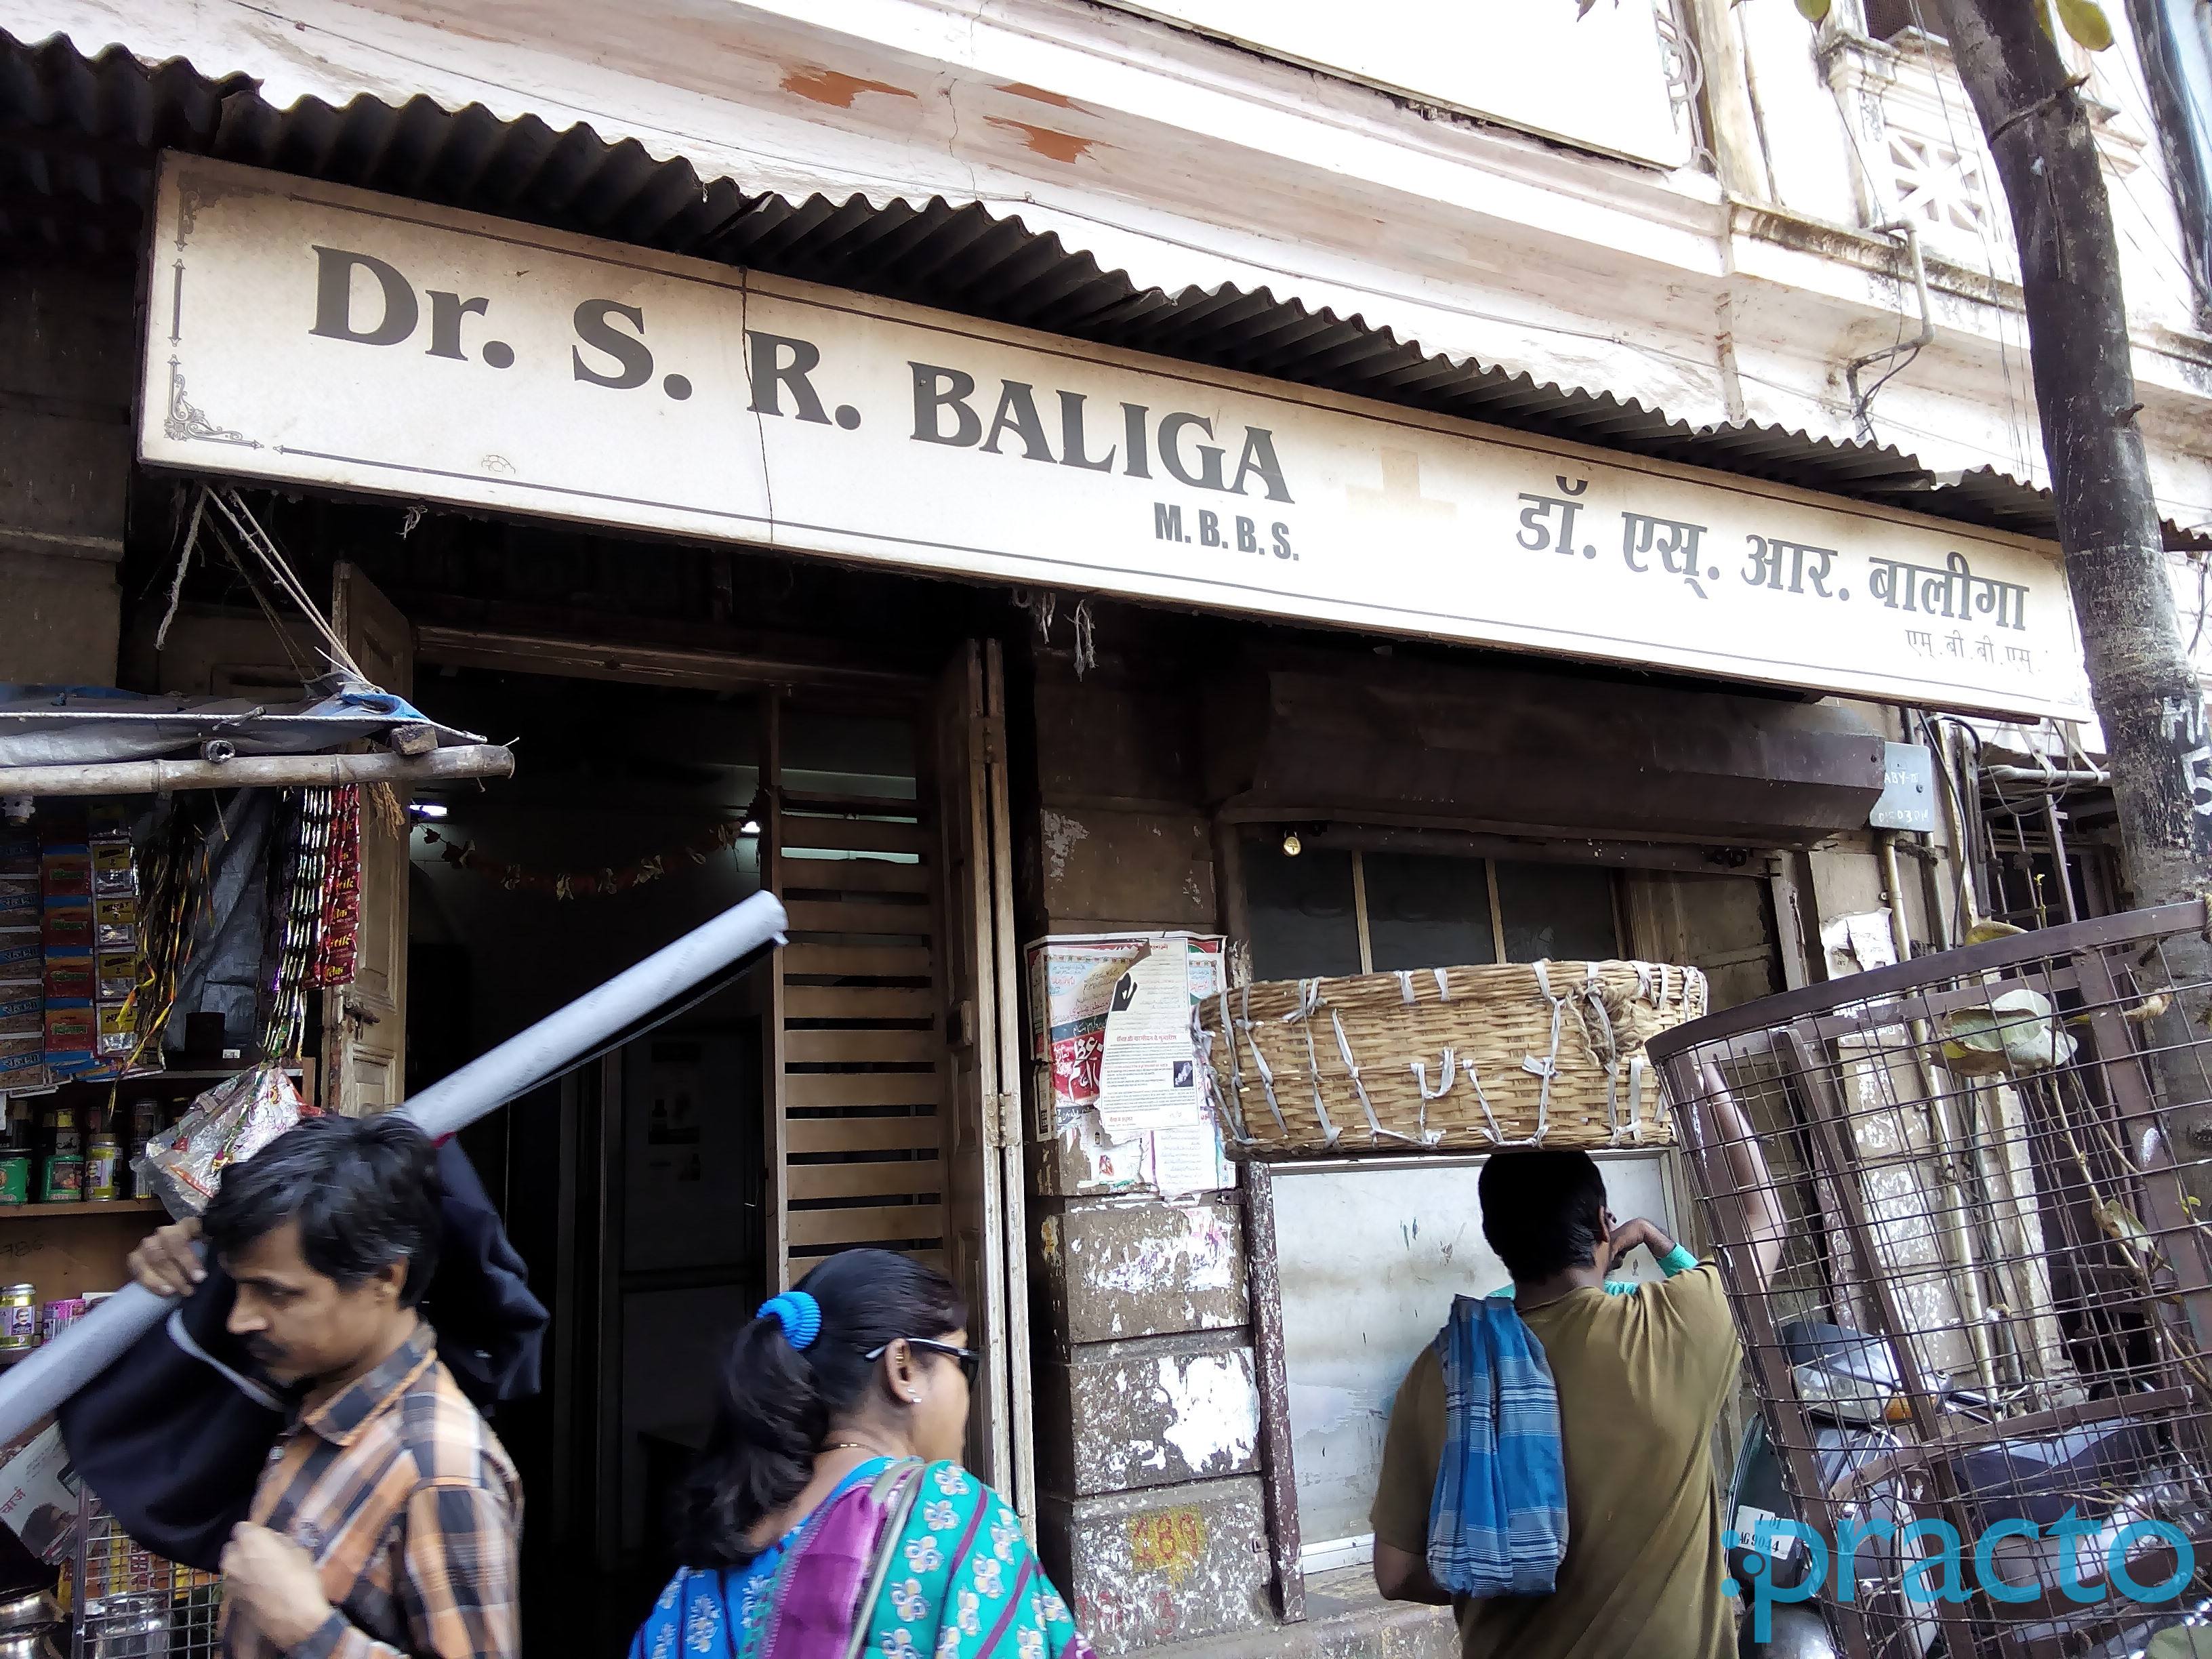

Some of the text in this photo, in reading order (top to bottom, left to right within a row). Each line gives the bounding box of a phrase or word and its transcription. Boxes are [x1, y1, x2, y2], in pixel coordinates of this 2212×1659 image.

[308, 244, 1296, 505] Dr. S. R. BALIGA
[1153, 501, 1300, 562] M.B.B.S.
[1515, 475, 1597, 559] डॉ.
[1740, 534, 1850, 602] आर.
[1868, 551, 2031, 632] बालीगा
[1132, 1513, 1199, 1560] 189
